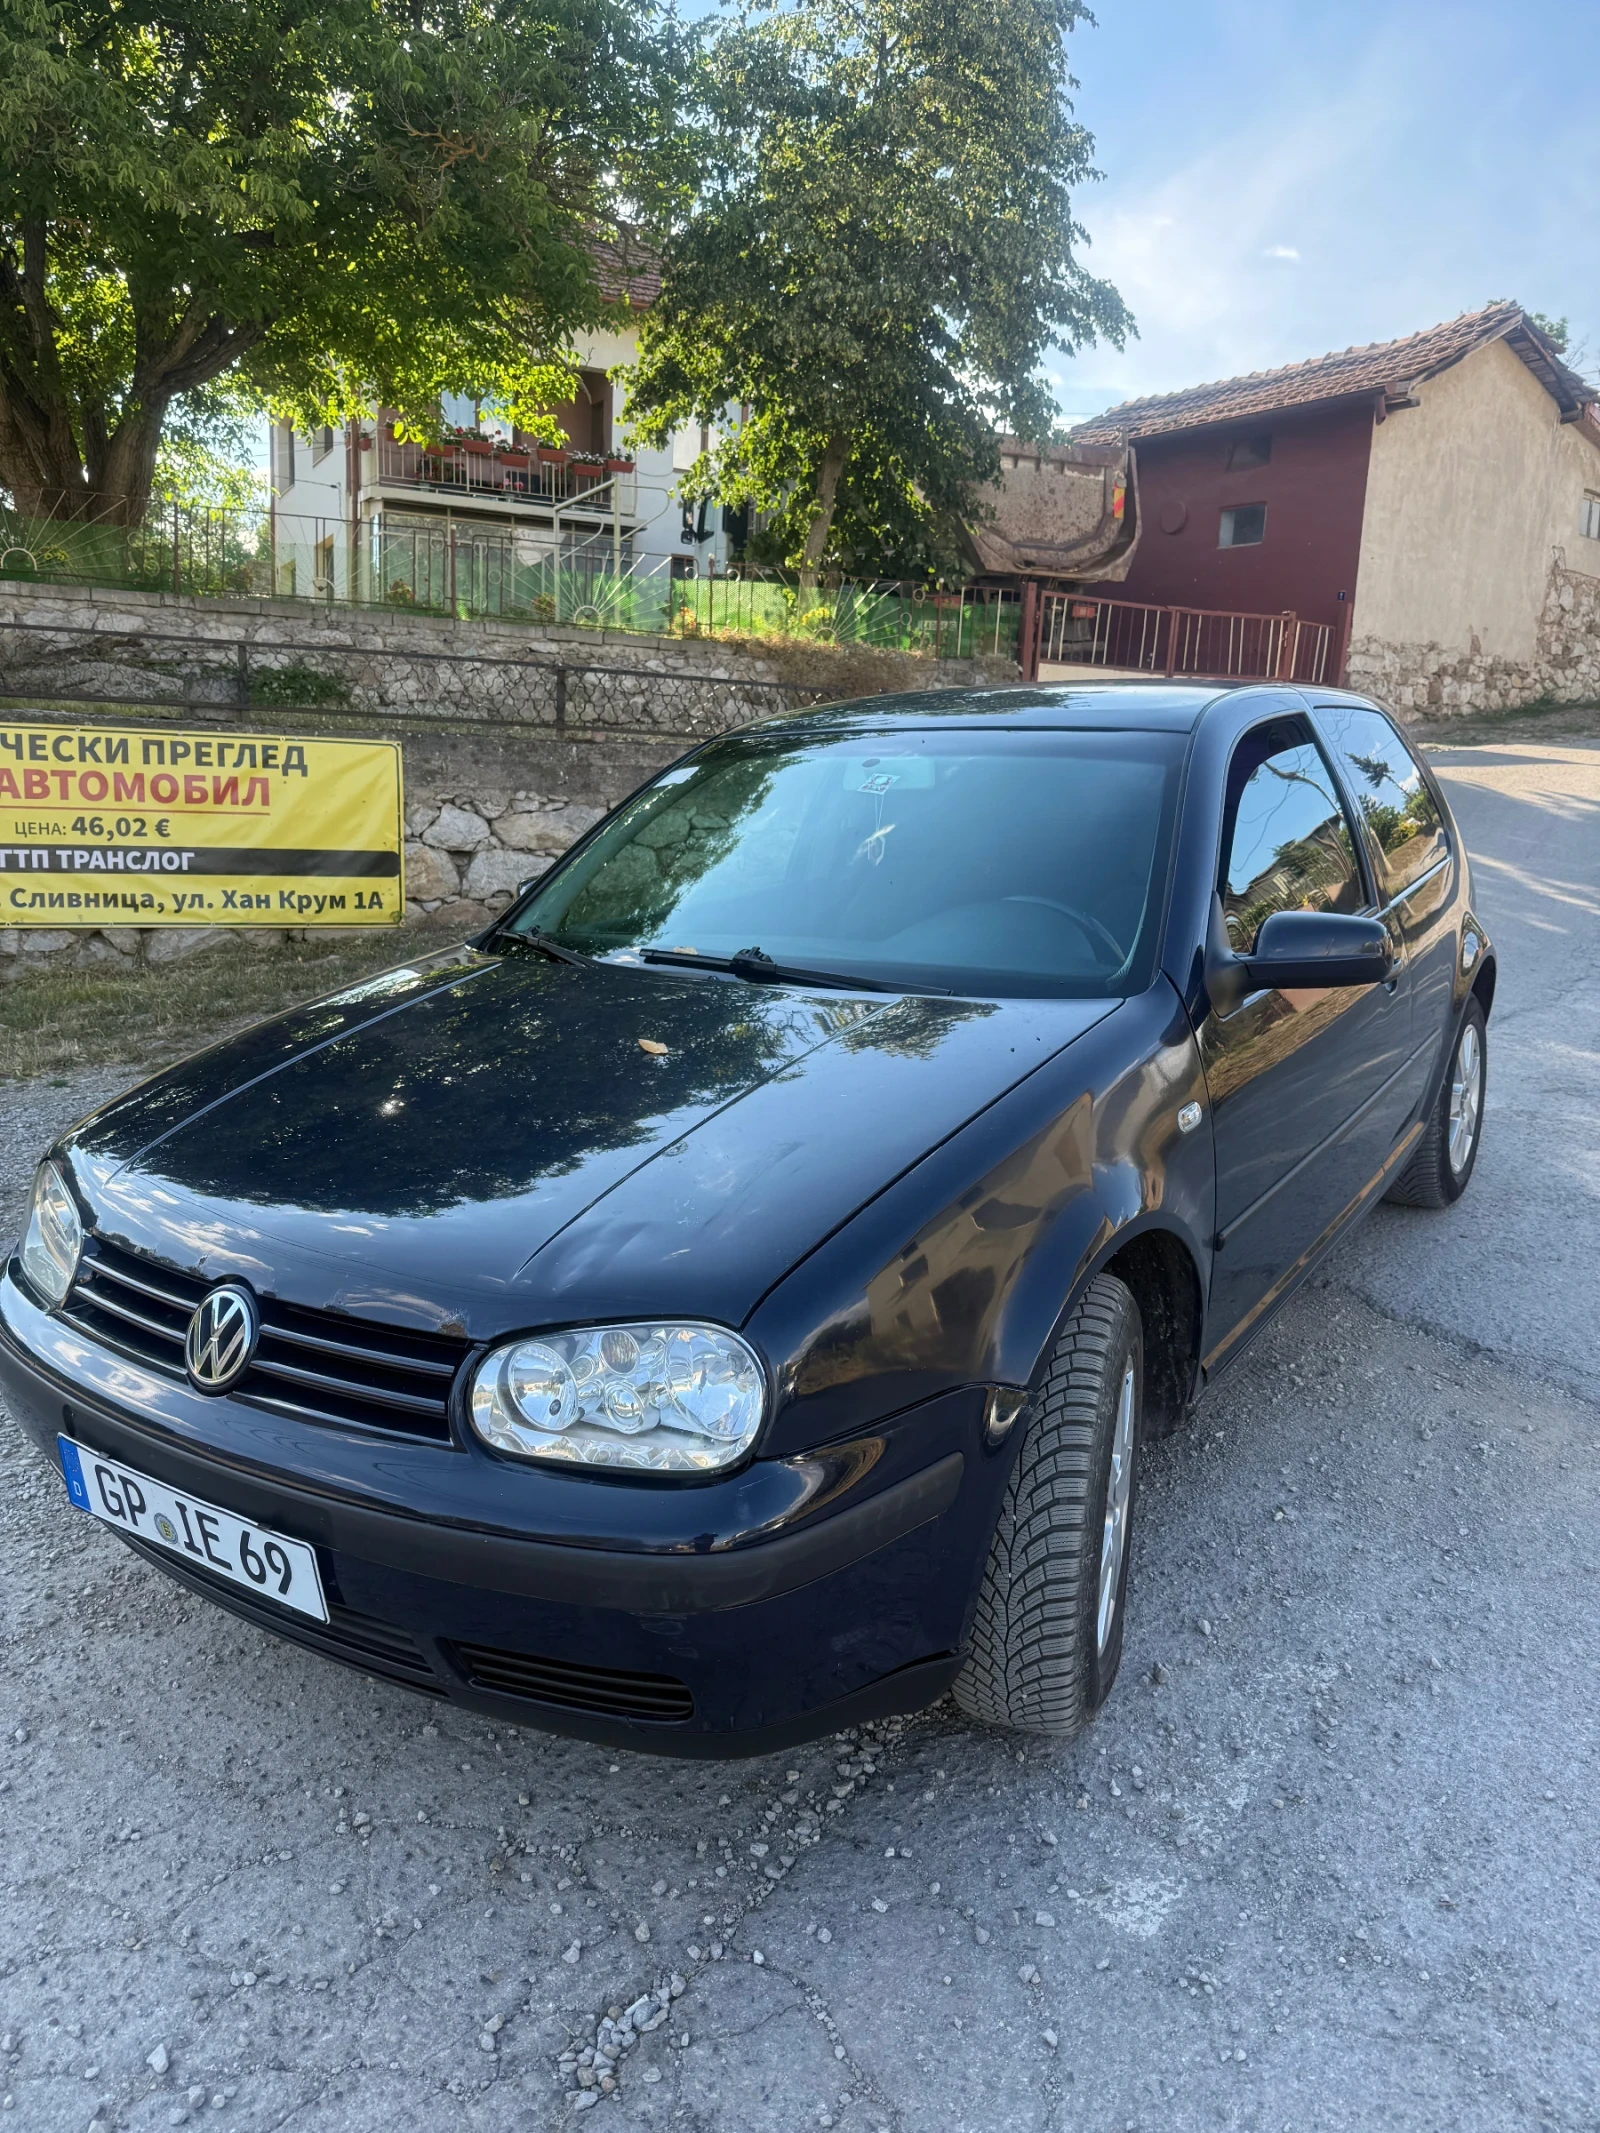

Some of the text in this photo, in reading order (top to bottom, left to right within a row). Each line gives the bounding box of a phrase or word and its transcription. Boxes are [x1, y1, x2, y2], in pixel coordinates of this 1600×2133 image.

[0, 733, 308, 777] ЧЕСКИ ПРЕГЛЕД
[0, 768, 271, 807] АВТОМОБИЛ
[15, 816, 171, 841] ЦЕНА: 46,02 €
[0, 849, 195, 871] ГТП ТРАНСЛОГ
[10, 887, 165, 914] Сливница,
[173, 891, 213, 914] ул.
[222, 889, 271, 909] Хан
[279, 890, 346, 914] Крум
[72, 1481, 83, 1498] D
[94, 1464, 293, 1596] GP IE 69
